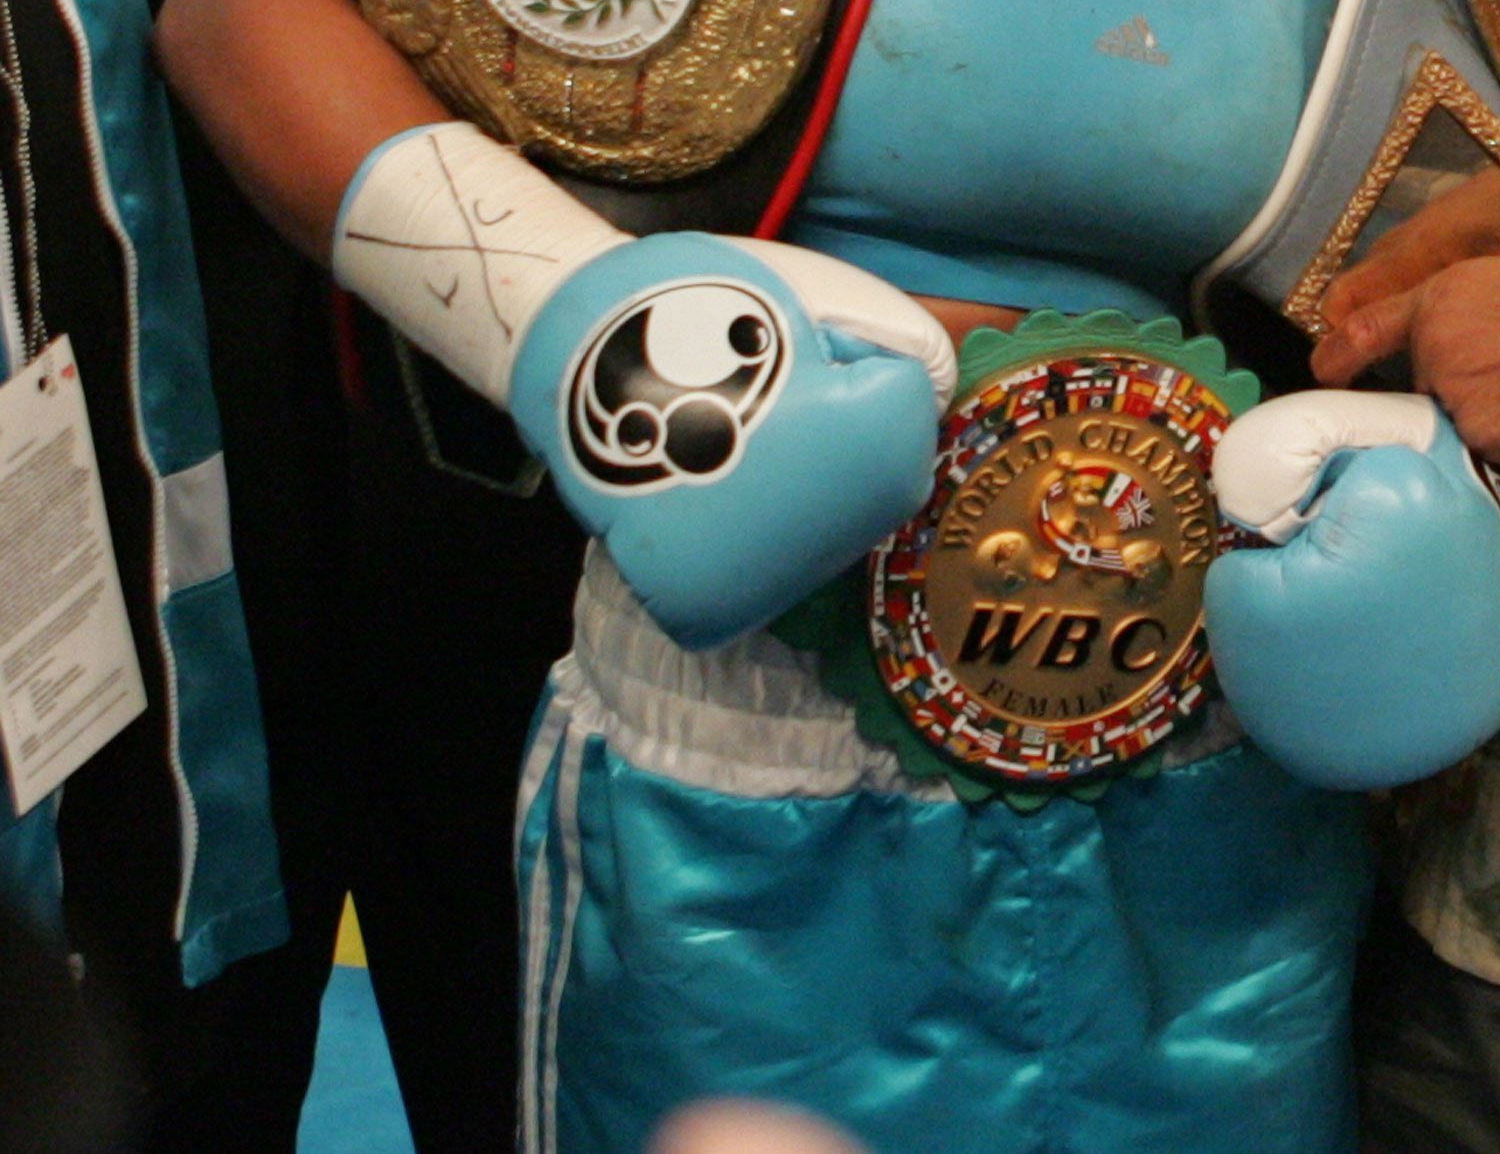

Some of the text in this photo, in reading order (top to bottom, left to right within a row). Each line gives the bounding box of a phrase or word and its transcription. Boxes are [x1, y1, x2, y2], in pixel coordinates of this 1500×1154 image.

[943, 418, 1210, 568] WORLD CHAMPION
[957, 601, 1167, 673] WBC
[980, 678, 1115, 717] FEMALE
